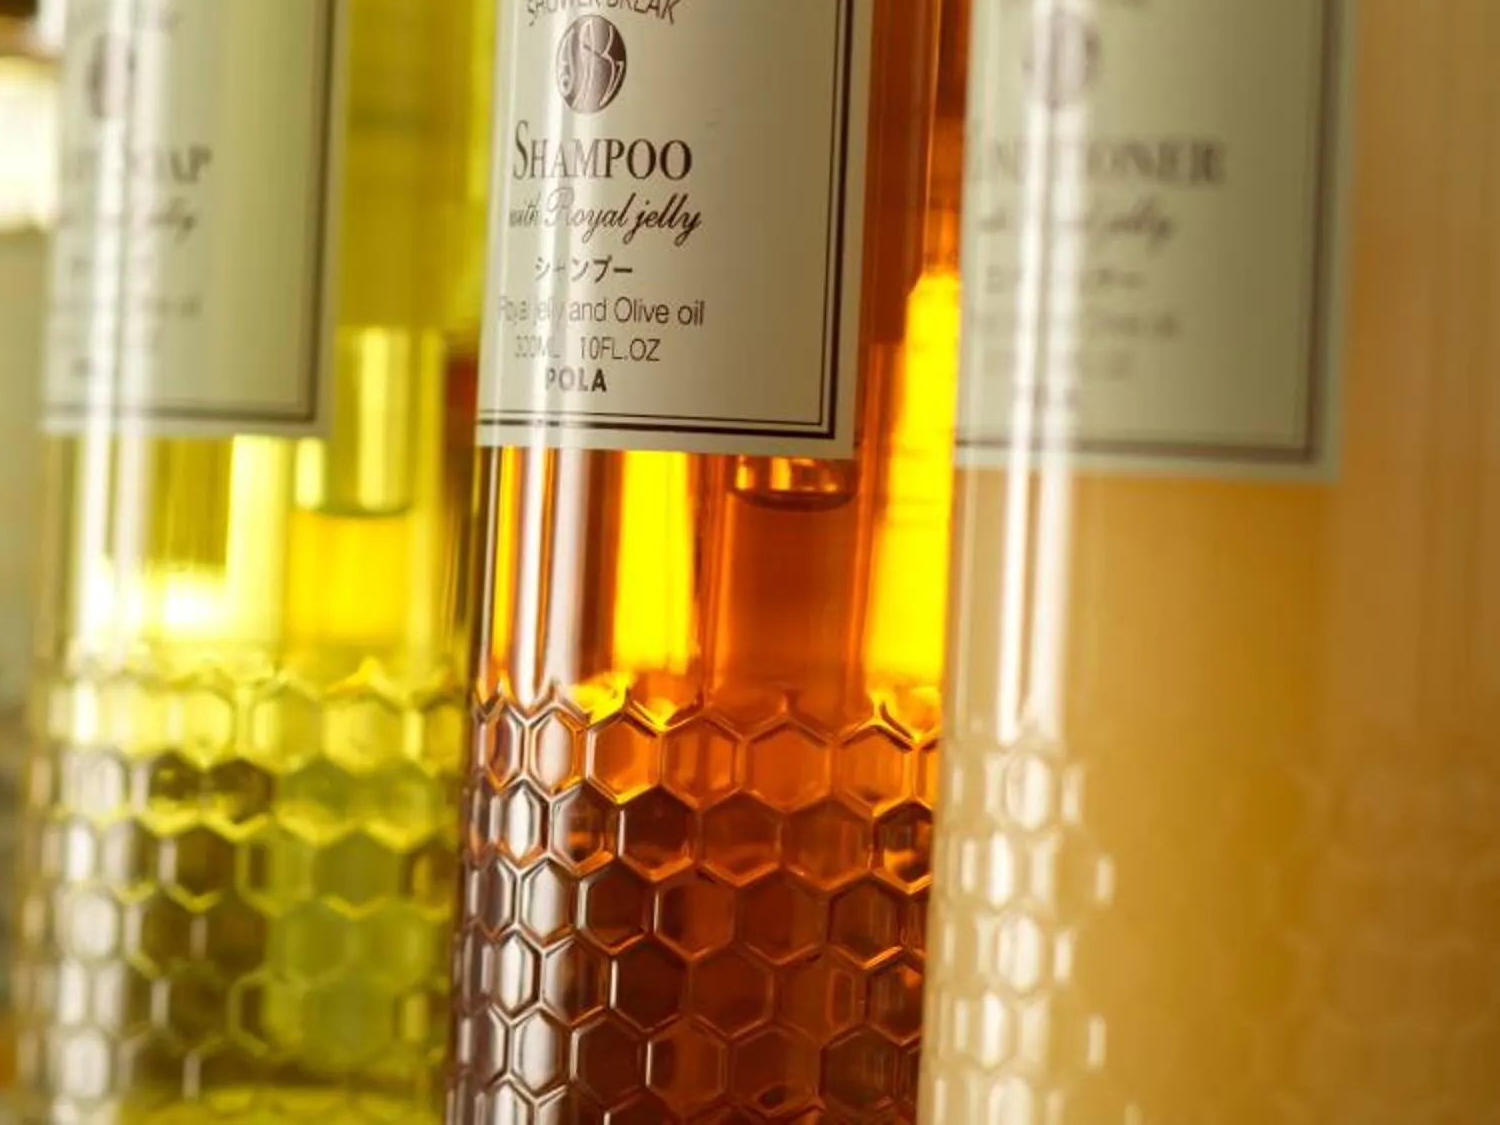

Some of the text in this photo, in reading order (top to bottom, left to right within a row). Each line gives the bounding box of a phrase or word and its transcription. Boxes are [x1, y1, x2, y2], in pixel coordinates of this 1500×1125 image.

[513, 119, 693, 180] SHAMPOO
[544, 186, 639, 245] Royal
[622, 192, 702, 247] jelly
[568, 296, 607, 323] and
[614, 296, 670, 325] Olive
[677, 298, 706, 327] oil
[579, 336, 661, 362] 10FL.OZ
[546, 367, 607, 393] POLA
